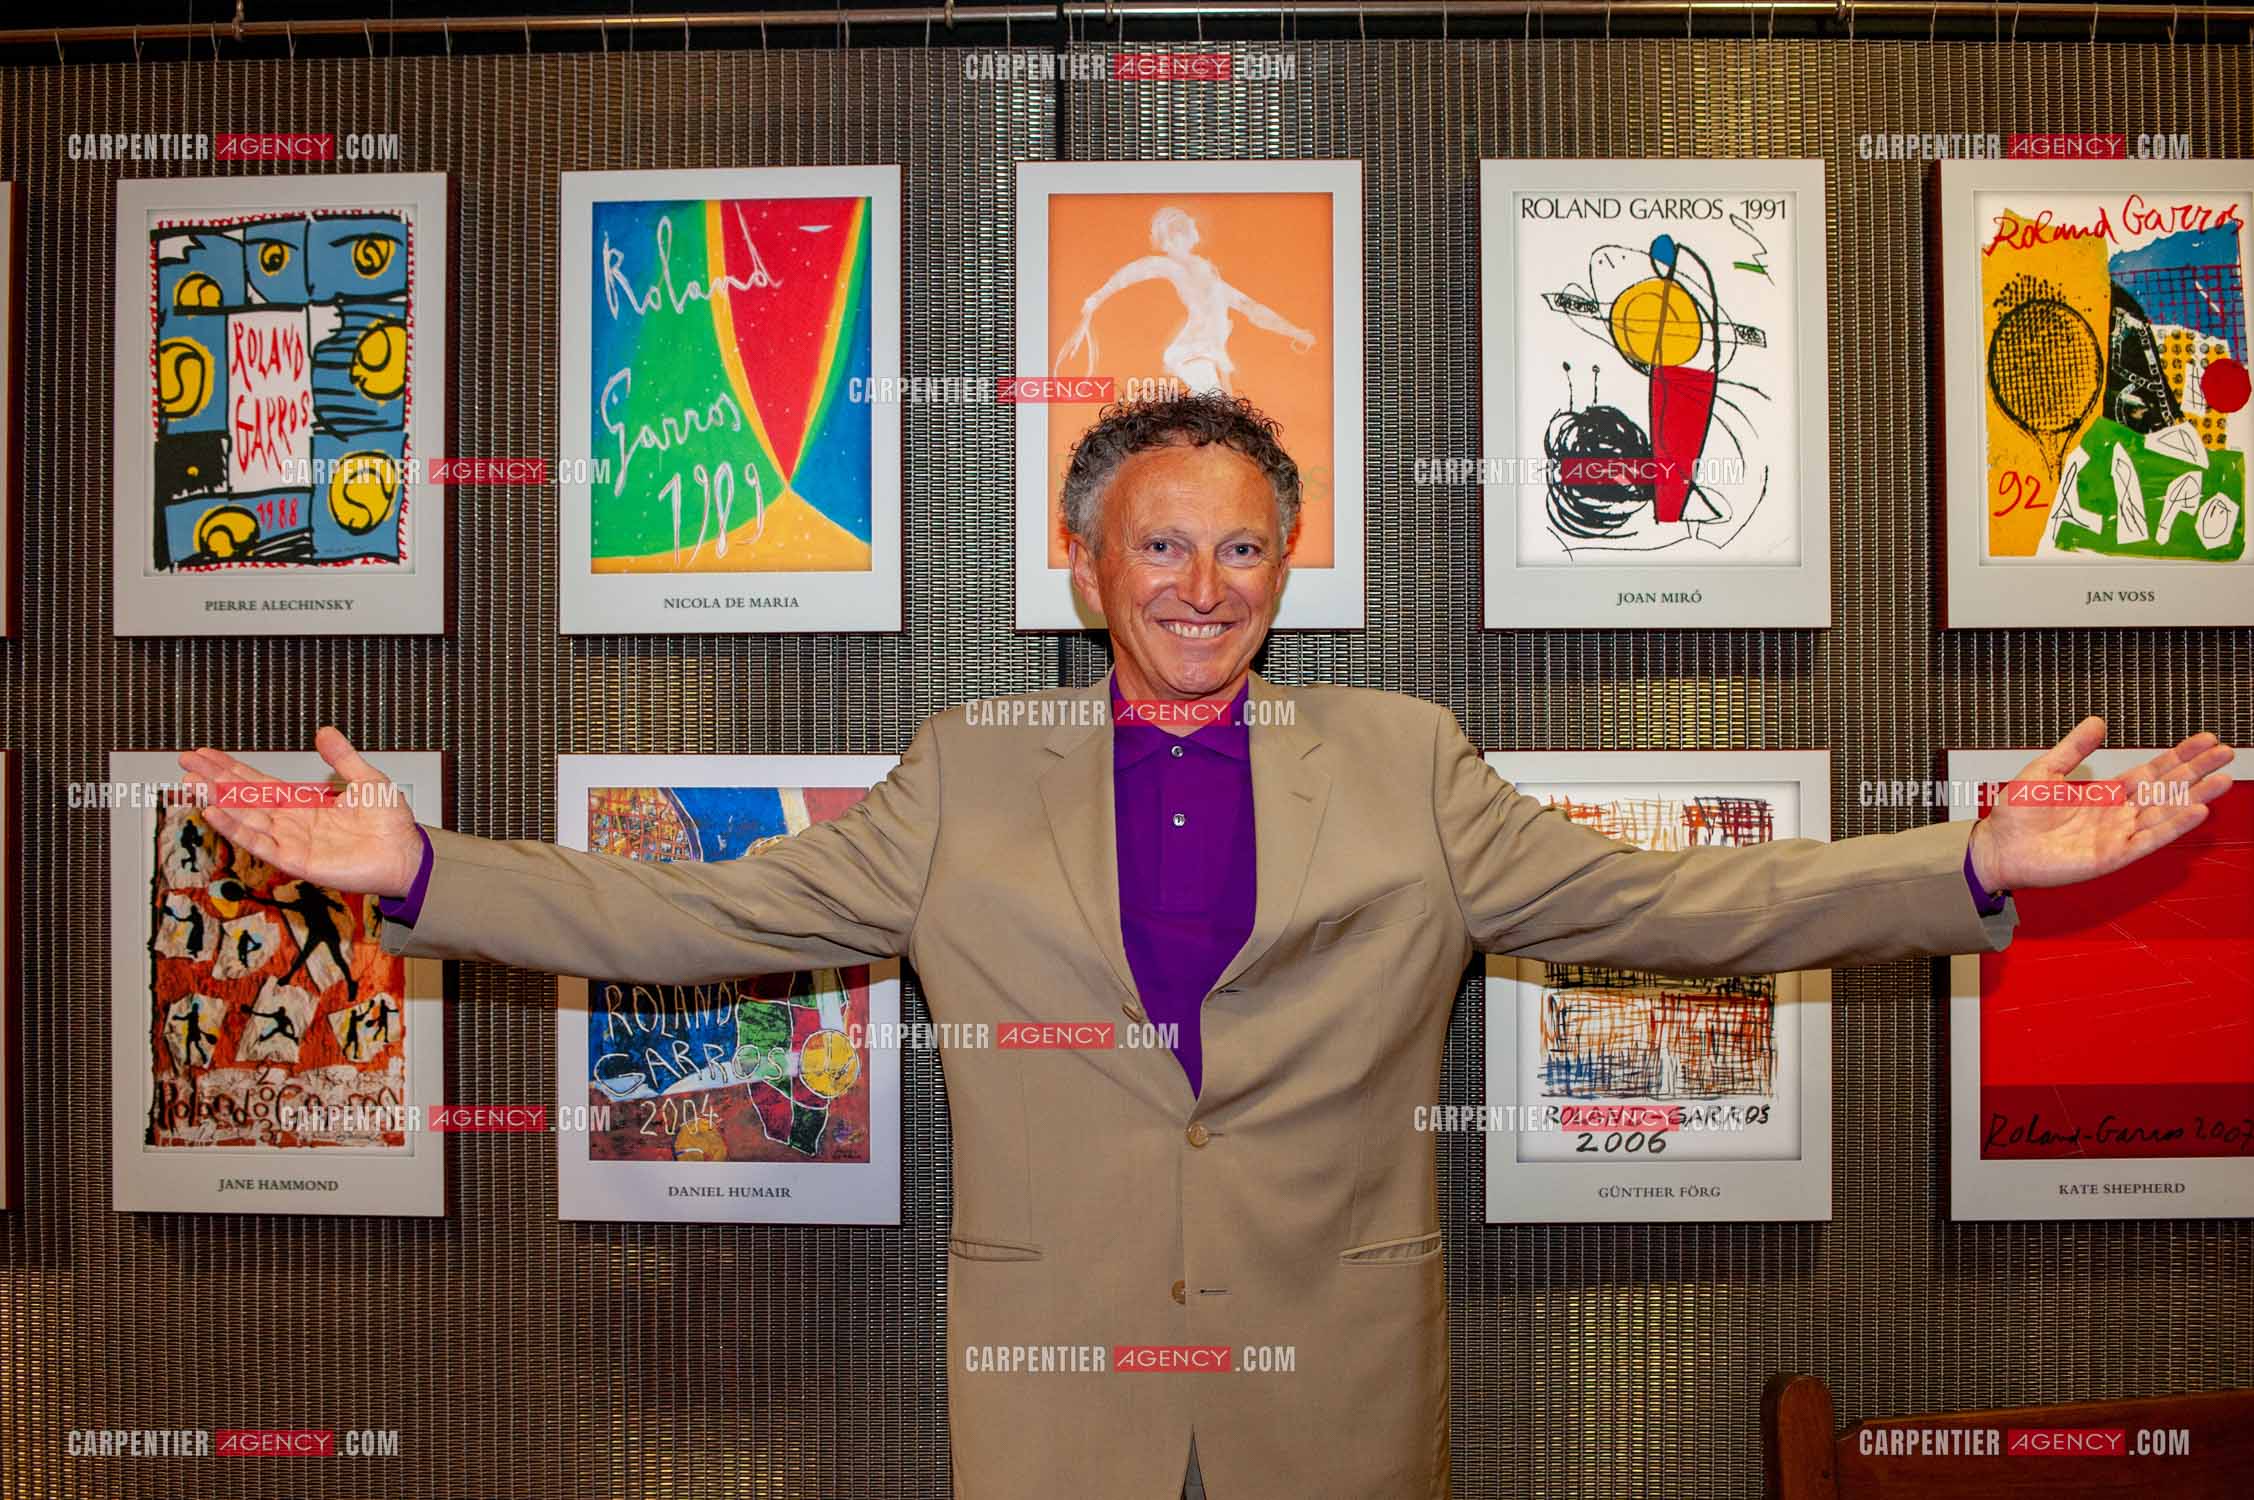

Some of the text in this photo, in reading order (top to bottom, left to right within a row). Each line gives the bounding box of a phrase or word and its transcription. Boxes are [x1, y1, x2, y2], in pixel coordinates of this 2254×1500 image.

[1521, 197, 1787, 220] ROLAND GARROS 1991
[1982, 194, 2244, 257] Roland Garros
[603, 202, 784, 320] Roland
[232, 321, 304, 392] ROLAND
[236, 390, 310, 474] GARROS
[600, 368, 741, 497] Garros
[1993, 471, 2049, 517] 92
[256, 498, 298, 530] 1988
[658, 463, 765, 567] 1989
[204, 600, 355, 611] PIERRE ALECHINSKY
[663, 597, 800, 609] NICOLA DE MARIA
[1616, 589, 1702, 606] JOAN MIRÓ
[2086, 591, 2156, 605] JAN VOSS
[604, 978, 732, 1040] ROLAND
[593, 1040, 785, 1097] GARROS
[639, 1094, 720, 1136] 2004
[1576, 1128, 1668, 1153] 2006
[218, 1179, 339, 1192] JANE HAMMOND
[668, 1186, 792, 1198] DANIEL HUMAIR
[1599, 1185, 1721, 1199] GÜNTHER FÖRG
[2058, 1183, 2186, 1196] KATE SHEPHERD
